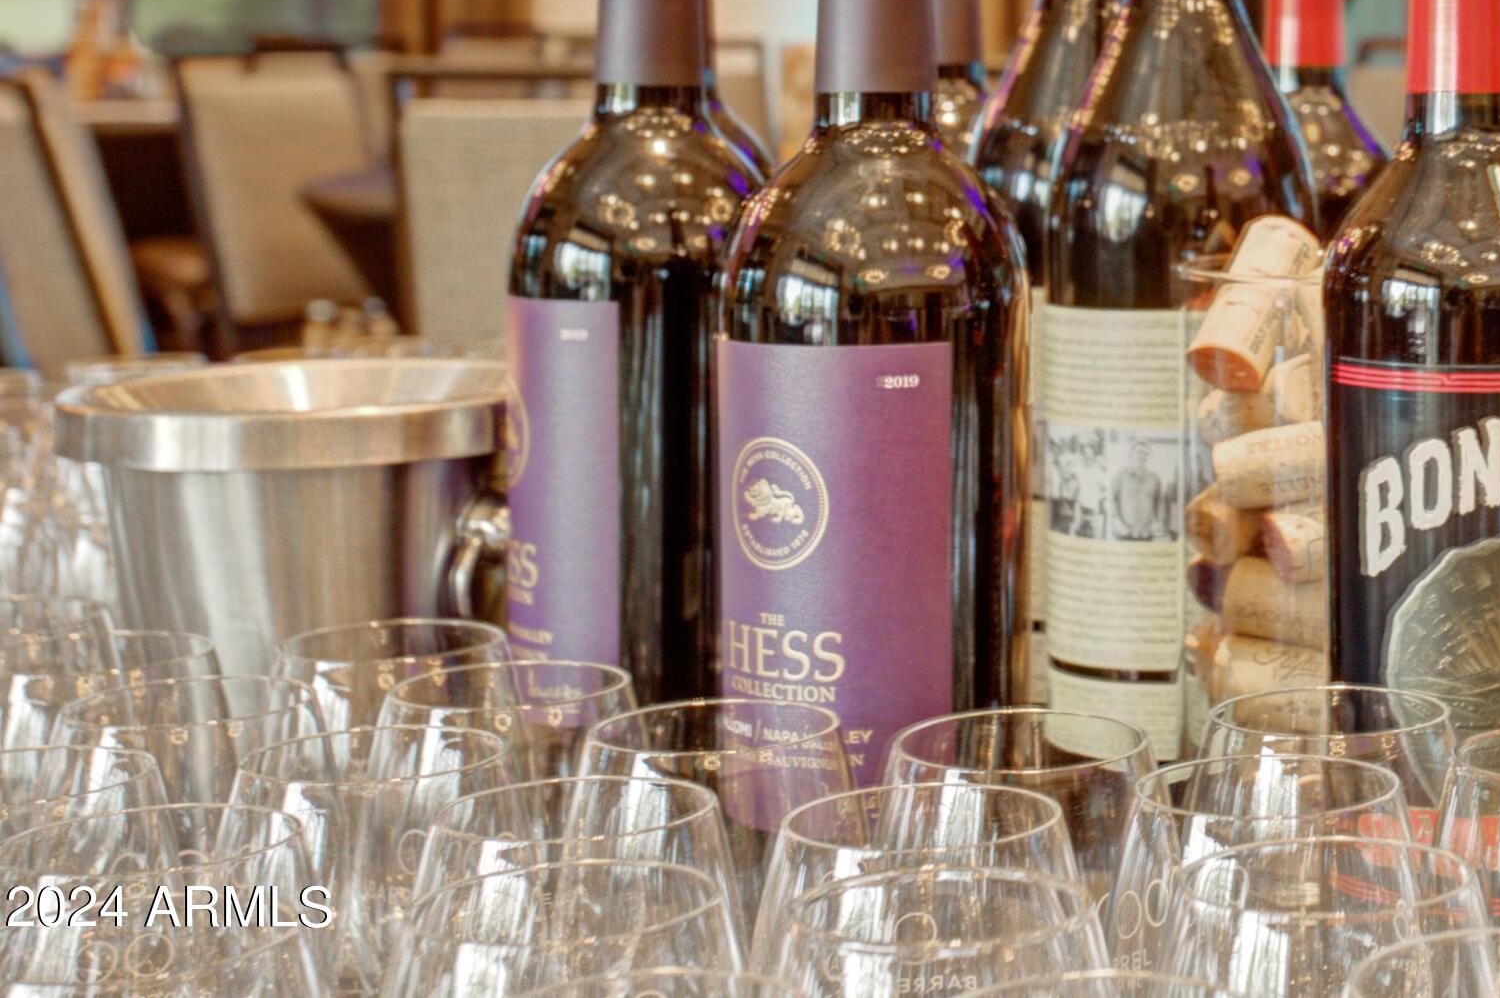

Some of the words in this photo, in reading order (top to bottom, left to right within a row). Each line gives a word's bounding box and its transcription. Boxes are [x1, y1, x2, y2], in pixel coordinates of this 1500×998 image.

[883, 373, 920, 389] 2019
[764, 449, 812, 490] COLLECTION
[760, 612, 785, 626] THE
[727, 619, 845, 683] HESS
[731, 674, 836, 702] COLLECTION
[763, 727, 800, 743] NAPA
